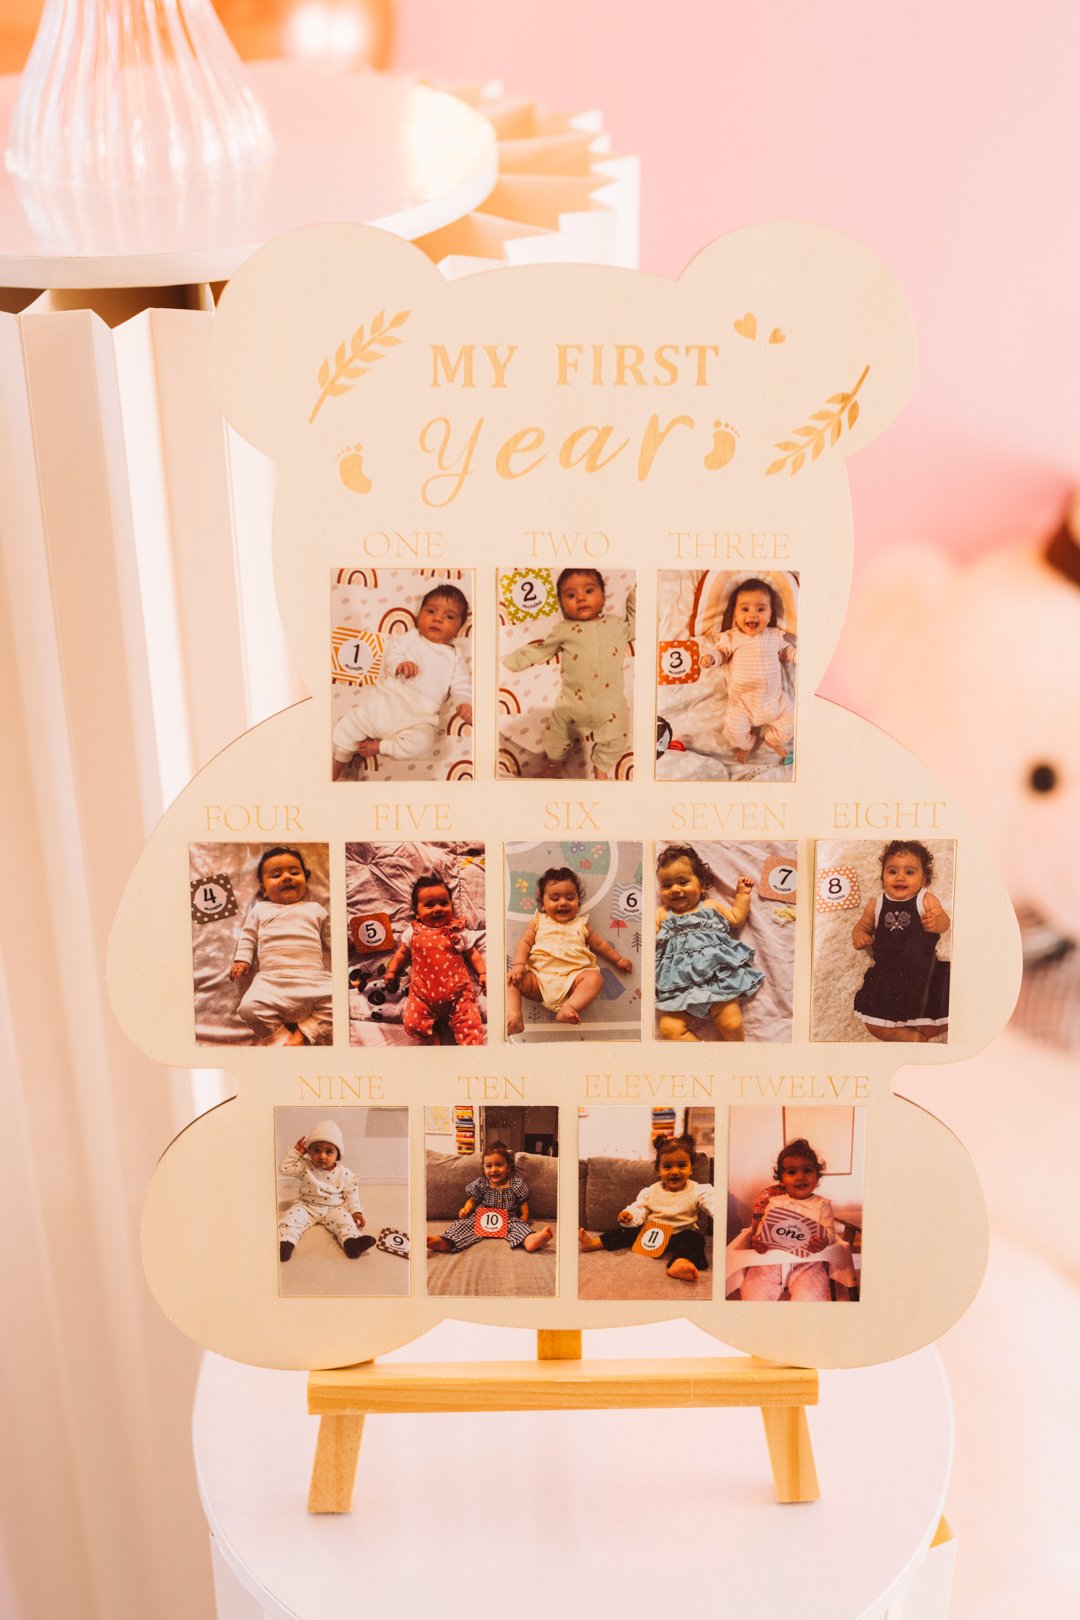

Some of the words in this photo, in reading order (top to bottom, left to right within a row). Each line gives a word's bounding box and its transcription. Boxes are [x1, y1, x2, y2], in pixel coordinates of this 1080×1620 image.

[430, 344, 519, 388] MY
[555, 344, 720, 387] FIRST
[363, 531, 443, 559] ONE
[523, 531, 610, 559] TWO
[668, 532, 790, 560] THREE
[521, 581, 537, 602] 2
[353, 644, 360, 664] 1
[669, 650, 683, 669] 3
[203, 804, 306, 833] FOUR
[374, 803, 453, 832] FIVE
[543, 801, 602, 831] SIX
[670, 802, 789, 831] SEVEN
[832, 801, 947, 830] EIGHT
[778, 868, 793, 885] 7
[828, 877, 842, 894] 8
[203, 888, 217, 903] 4
[626, 892, 638, 908] 6
[365, 923, 377, 939] 5
[297, 1075, 385, 1100] NINE
[457, 1075, 528, 1100] TEN
[584, 1074, 716, 1099] ELEVEN
[730, 1074, 871, 1099] TWELVE
[486, 1214, 499, 1226] 10
[393, 1235, 404, 1246] 9
[648, 1230, 659, 1244] 11
[776, 1226, 807, 1242] one
